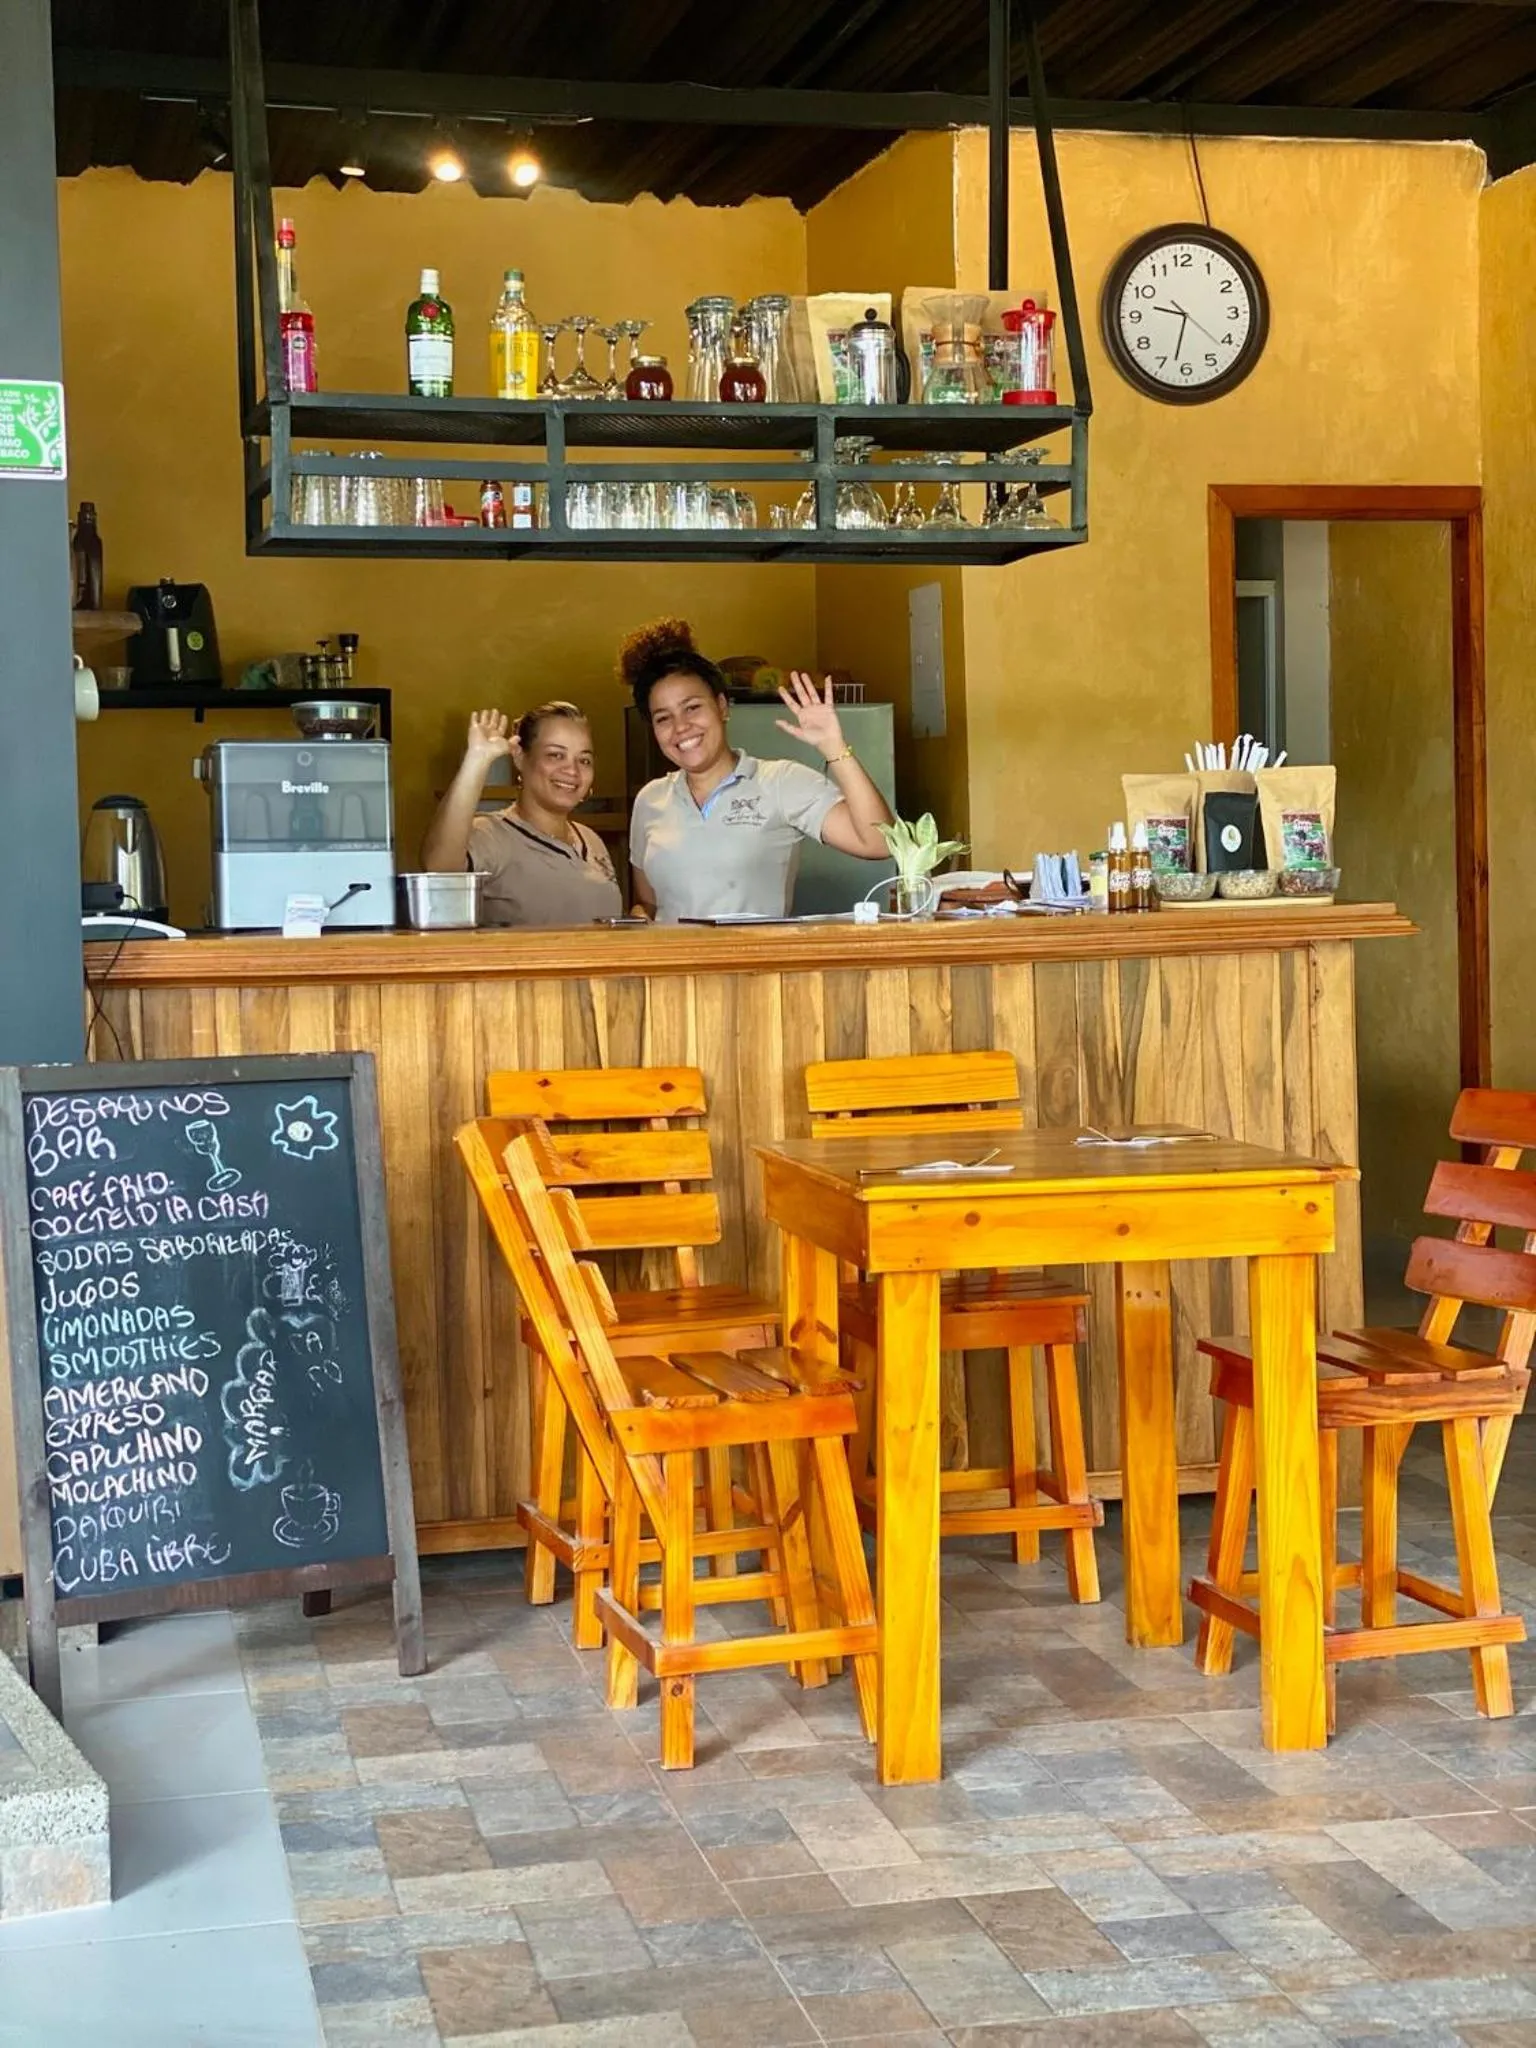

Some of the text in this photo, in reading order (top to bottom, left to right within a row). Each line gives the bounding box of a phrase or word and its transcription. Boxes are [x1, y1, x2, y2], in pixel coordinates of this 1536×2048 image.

[1172, 253, 1194, 268] 12
[1151, 263, 1168, 278] 11
[1205, 262, 1212, 275] 1
[1134, 284, 1156, 299] 10
[1220, 280, 1233, 293] 2
[1129, 310, 1143, 324] 9
[1226, 306, 1240, 320] 3
[1137, 336, 1151, 350] 8
[1221, 333, 1234, 346] 4
[1155, 356, 1168, 369] 7
[1204, 353, 1218, 367] 5
[1180, 363, 1193, 376] 6
[281, 780, 330, 794] Breville
[28, 1126, 117, 1177] BAR
[198, 1190, 270, 1222] CASA
[37, 1227, 294, 1276] SODAS SABORIZADAS
[41, 1271, 141, 1314] JUGOS
[43, 1364, 210, 1421] AMERICANO
[46, 1402, 166, 1448] EXPRESO
[46, 1422, 204, 1484] CAPUCHINO
[50, 1461, 199, 1509] MOCACHINO
[53, 1545, 140, 1592] CUBA
